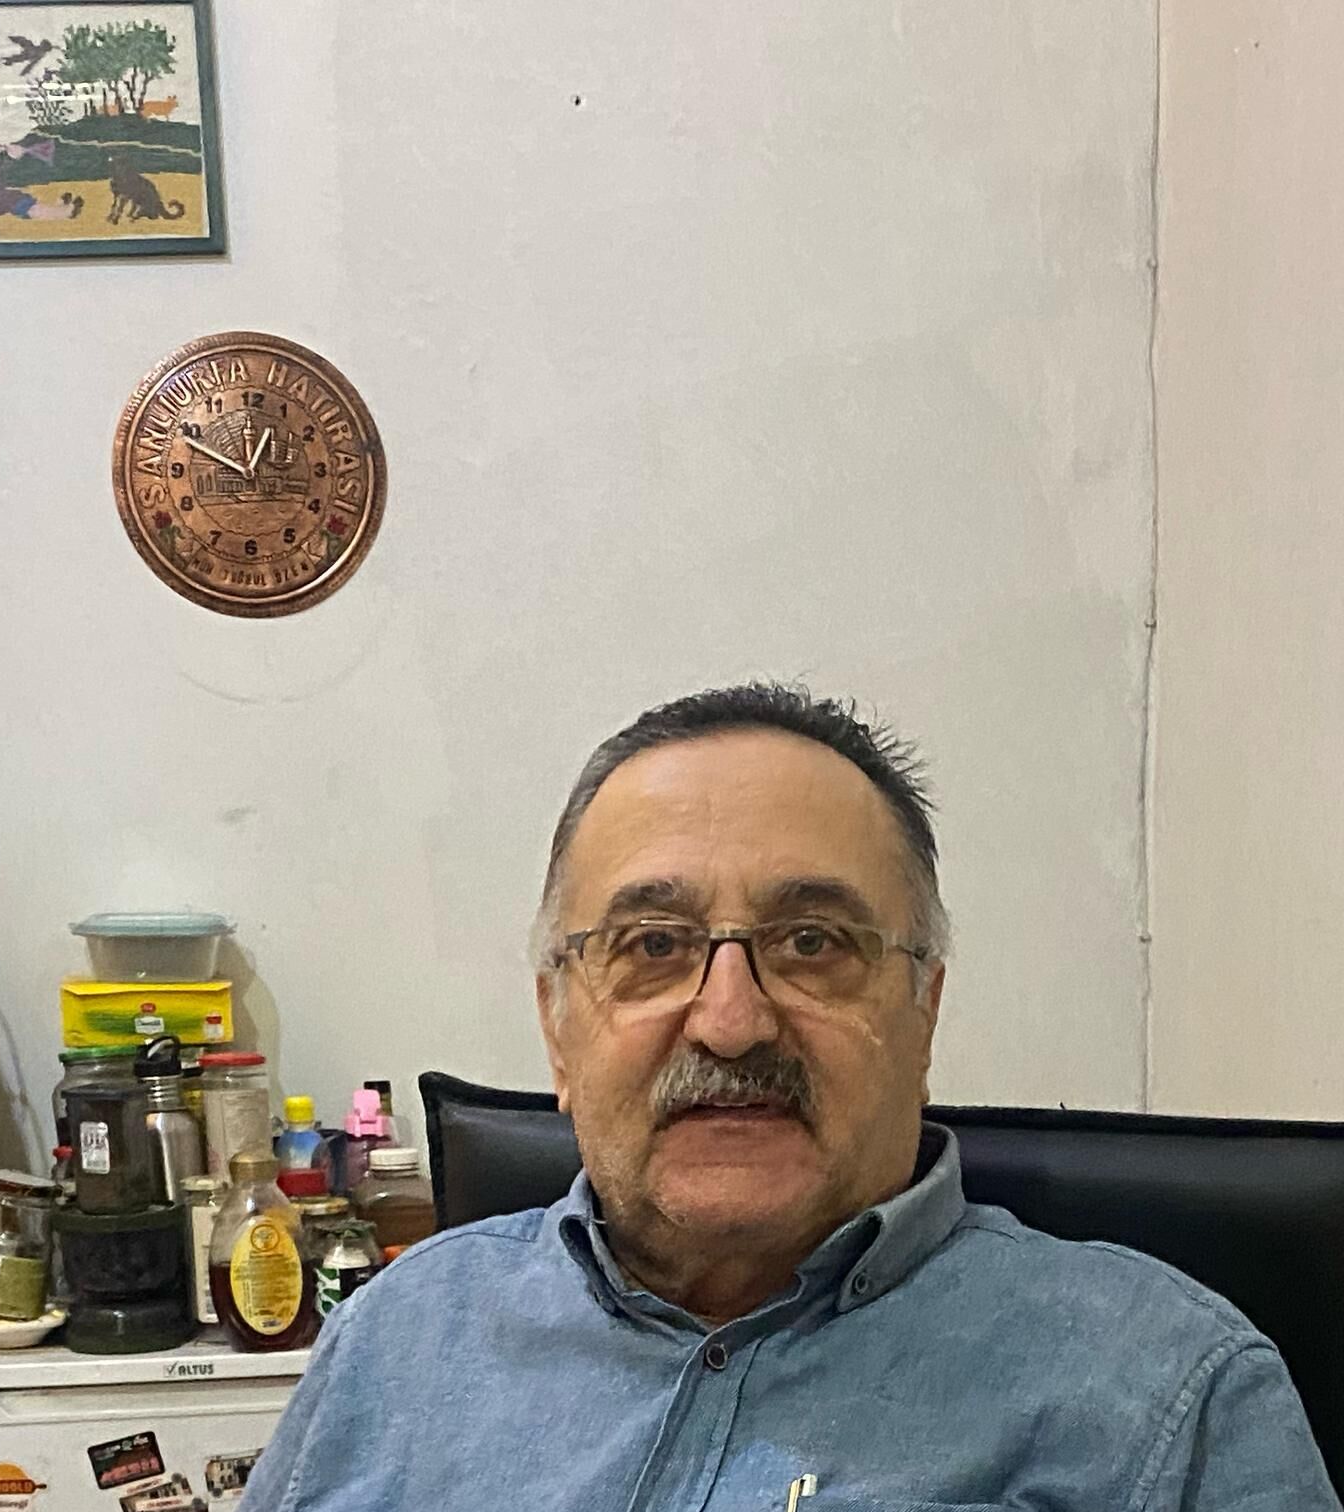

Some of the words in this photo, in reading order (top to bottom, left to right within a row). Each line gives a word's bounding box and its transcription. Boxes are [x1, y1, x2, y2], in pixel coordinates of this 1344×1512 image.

[204, 400, 224, 414] 11
[241, 392, 265, 409] 12
[279, 402, 288, 418] 1
[302, 425, 316, 442] 2
[170, 462, 185, 479] 9
[314, 462, 327, 478] 3
[180, 496, 194, 512] 8
[307, 499, 320, 514] 4
[209, 531, 222, 546] 7
[283, 528, 296, 544] 5
[244, 540, 258, 556] 6
[178, 1364, 214, 1376] ALTUS
